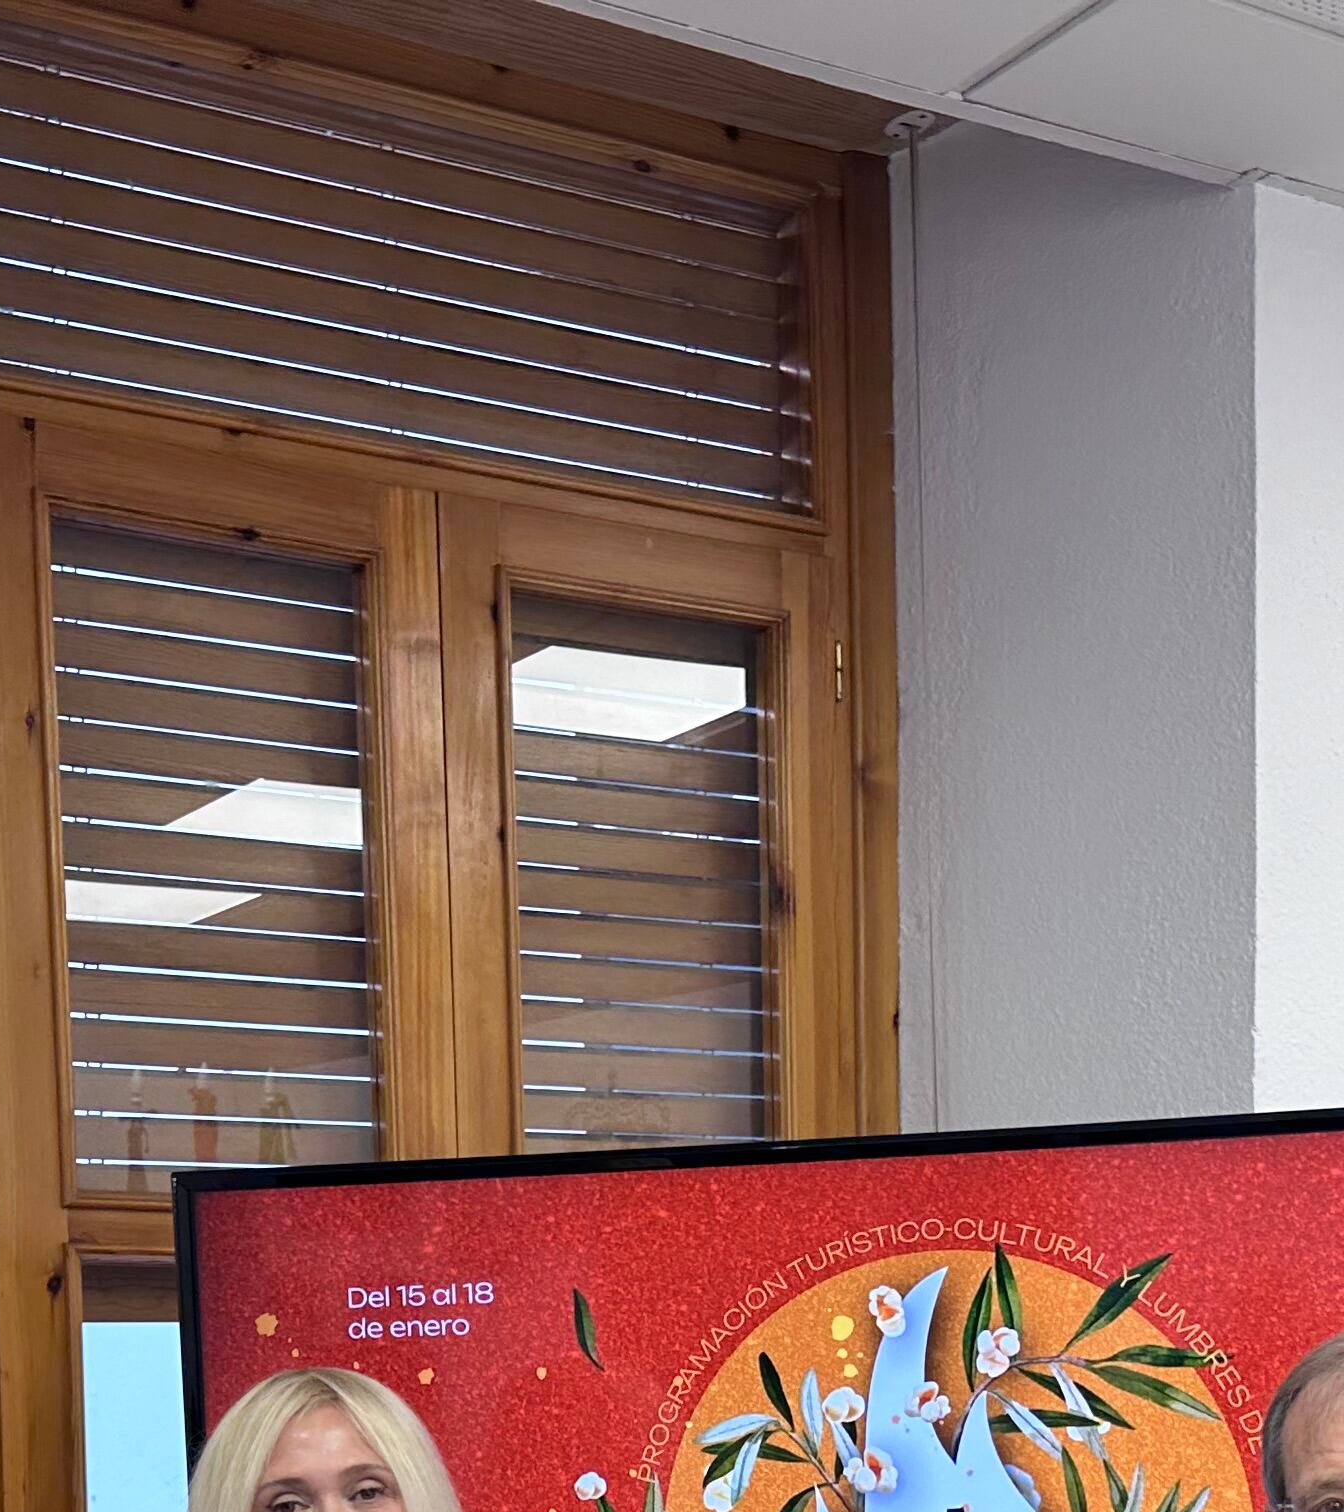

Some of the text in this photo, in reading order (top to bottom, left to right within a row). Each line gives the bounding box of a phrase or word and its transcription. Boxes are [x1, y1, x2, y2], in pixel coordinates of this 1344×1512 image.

[347, 1281, 494, 1309] Del 15 al 18
[348, 1317, 470, 1339] de enero
[636, 1271, 789, 1484] PROGRAMACIÓN
[786, 1217, 1111, 1280] TURÍSTICO-CULTURAL
[1120, 1264, 1141, 1288] Y
[1137, 1280, 1251, 1409] LUMBRES
